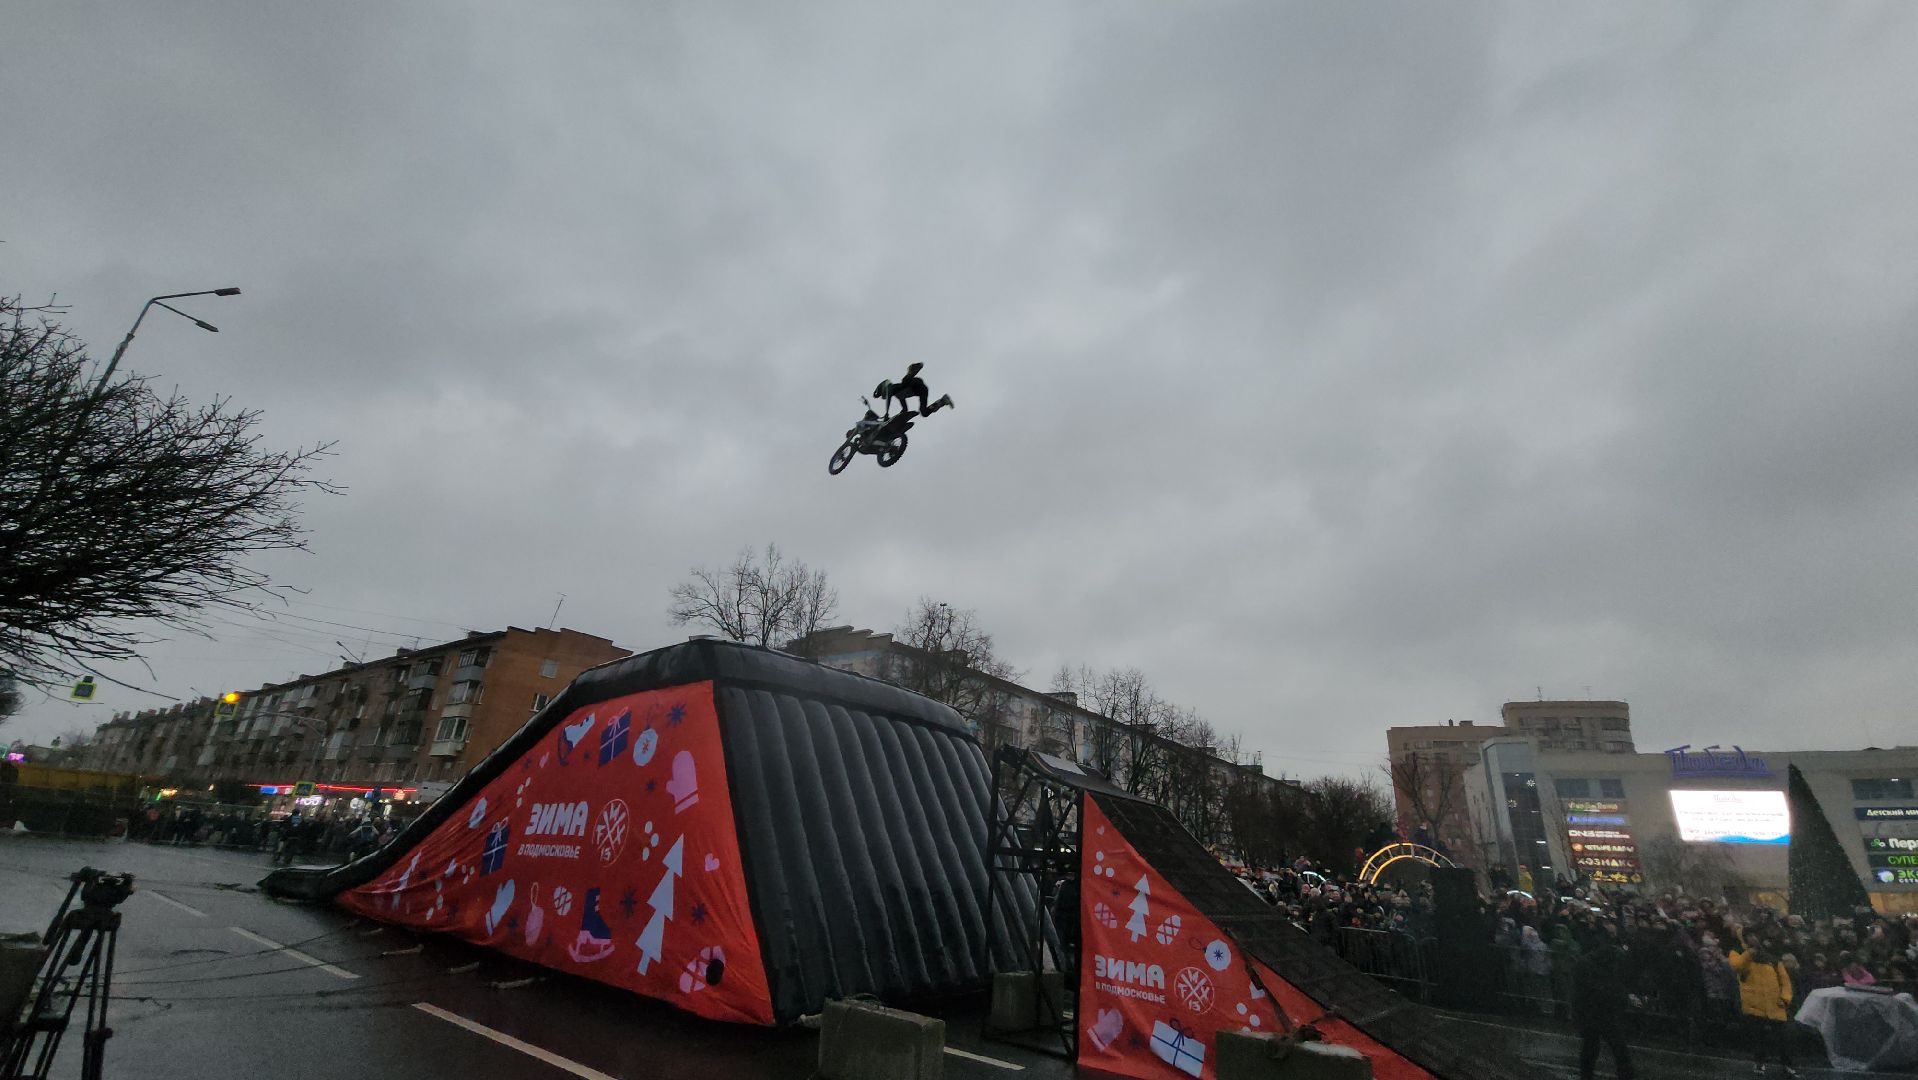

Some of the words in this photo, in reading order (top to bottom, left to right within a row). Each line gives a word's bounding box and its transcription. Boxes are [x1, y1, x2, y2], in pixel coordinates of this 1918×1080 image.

[525, 801, 588, 836] ЗИМА
[1568, 829, 1595, 838] DNS
[1888, 838, 1918, 850] Пер
[1095, 955, 1165, 989] ЗИМА
[1102, 984, 1165, 1004] ПОДМОСКОВЬЕ
